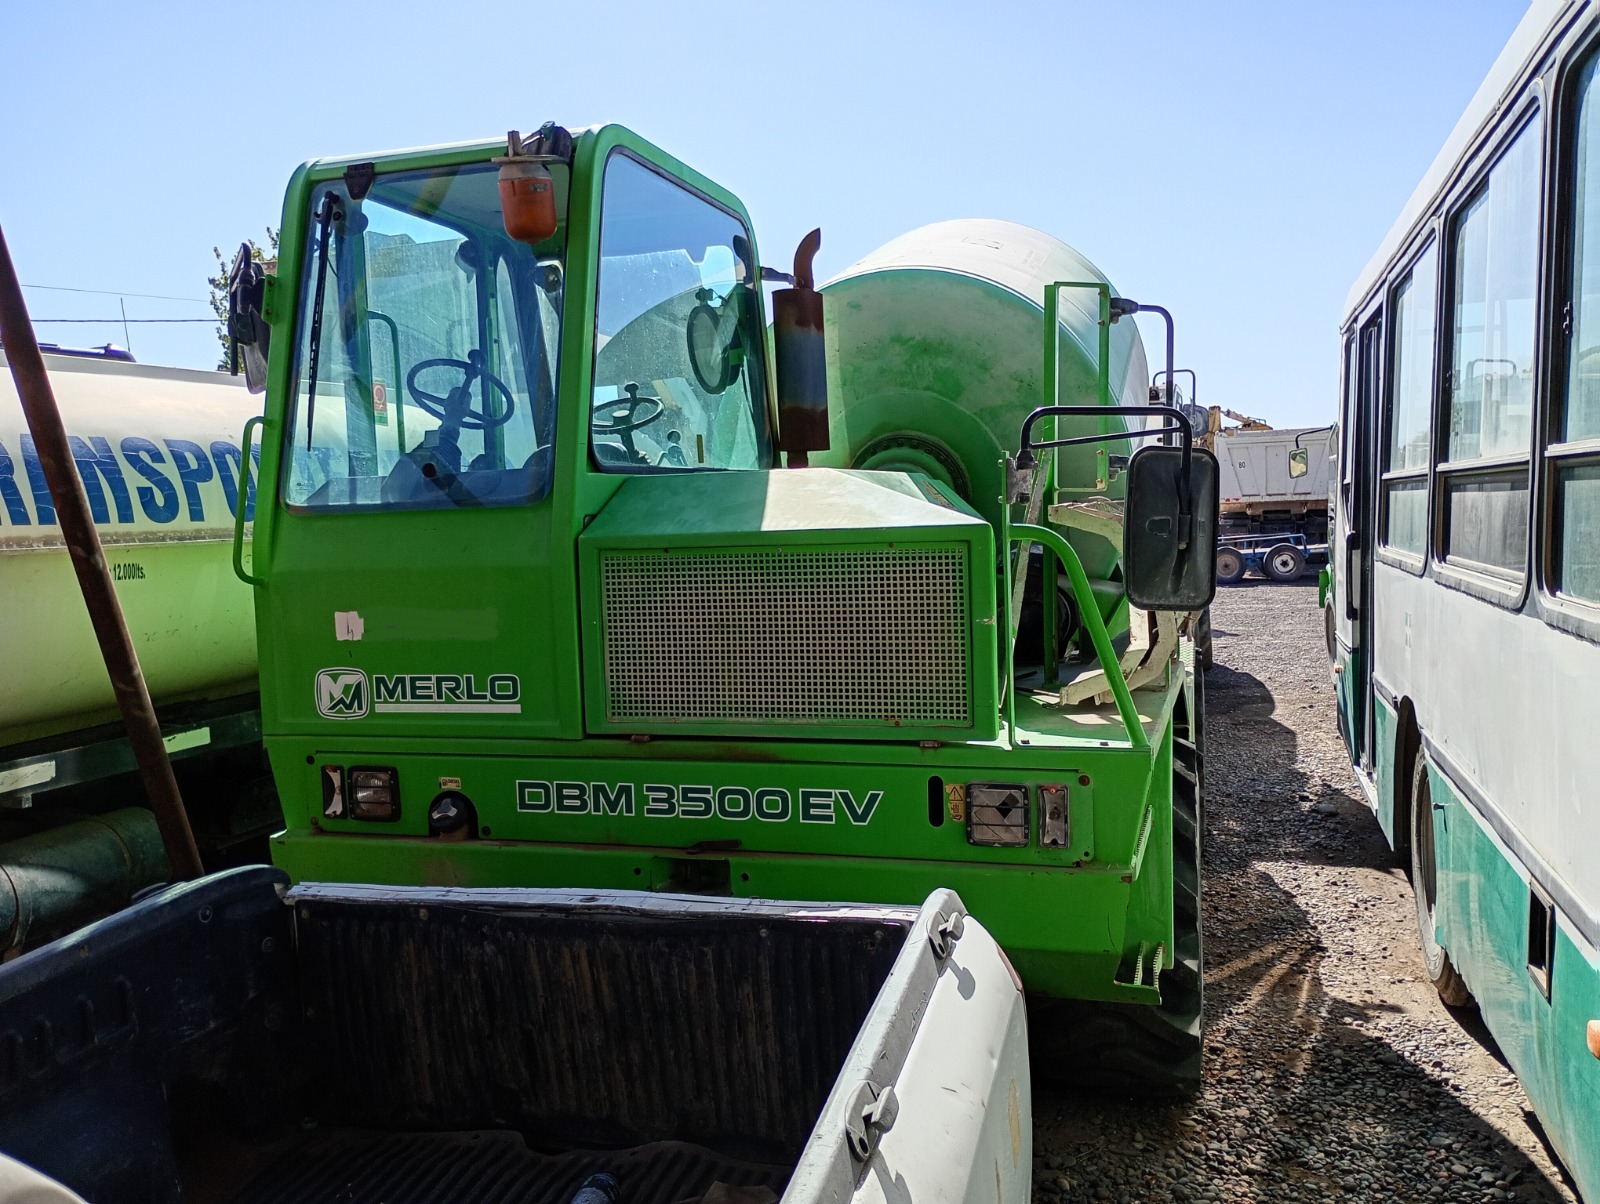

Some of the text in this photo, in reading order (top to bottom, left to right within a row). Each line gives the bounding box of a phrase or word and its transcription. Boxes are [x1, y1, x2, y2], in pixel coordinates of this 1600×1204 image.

[373, 674, 520, 702] MERLO
[516, 780, 884, 826] DBM 3500 EV
